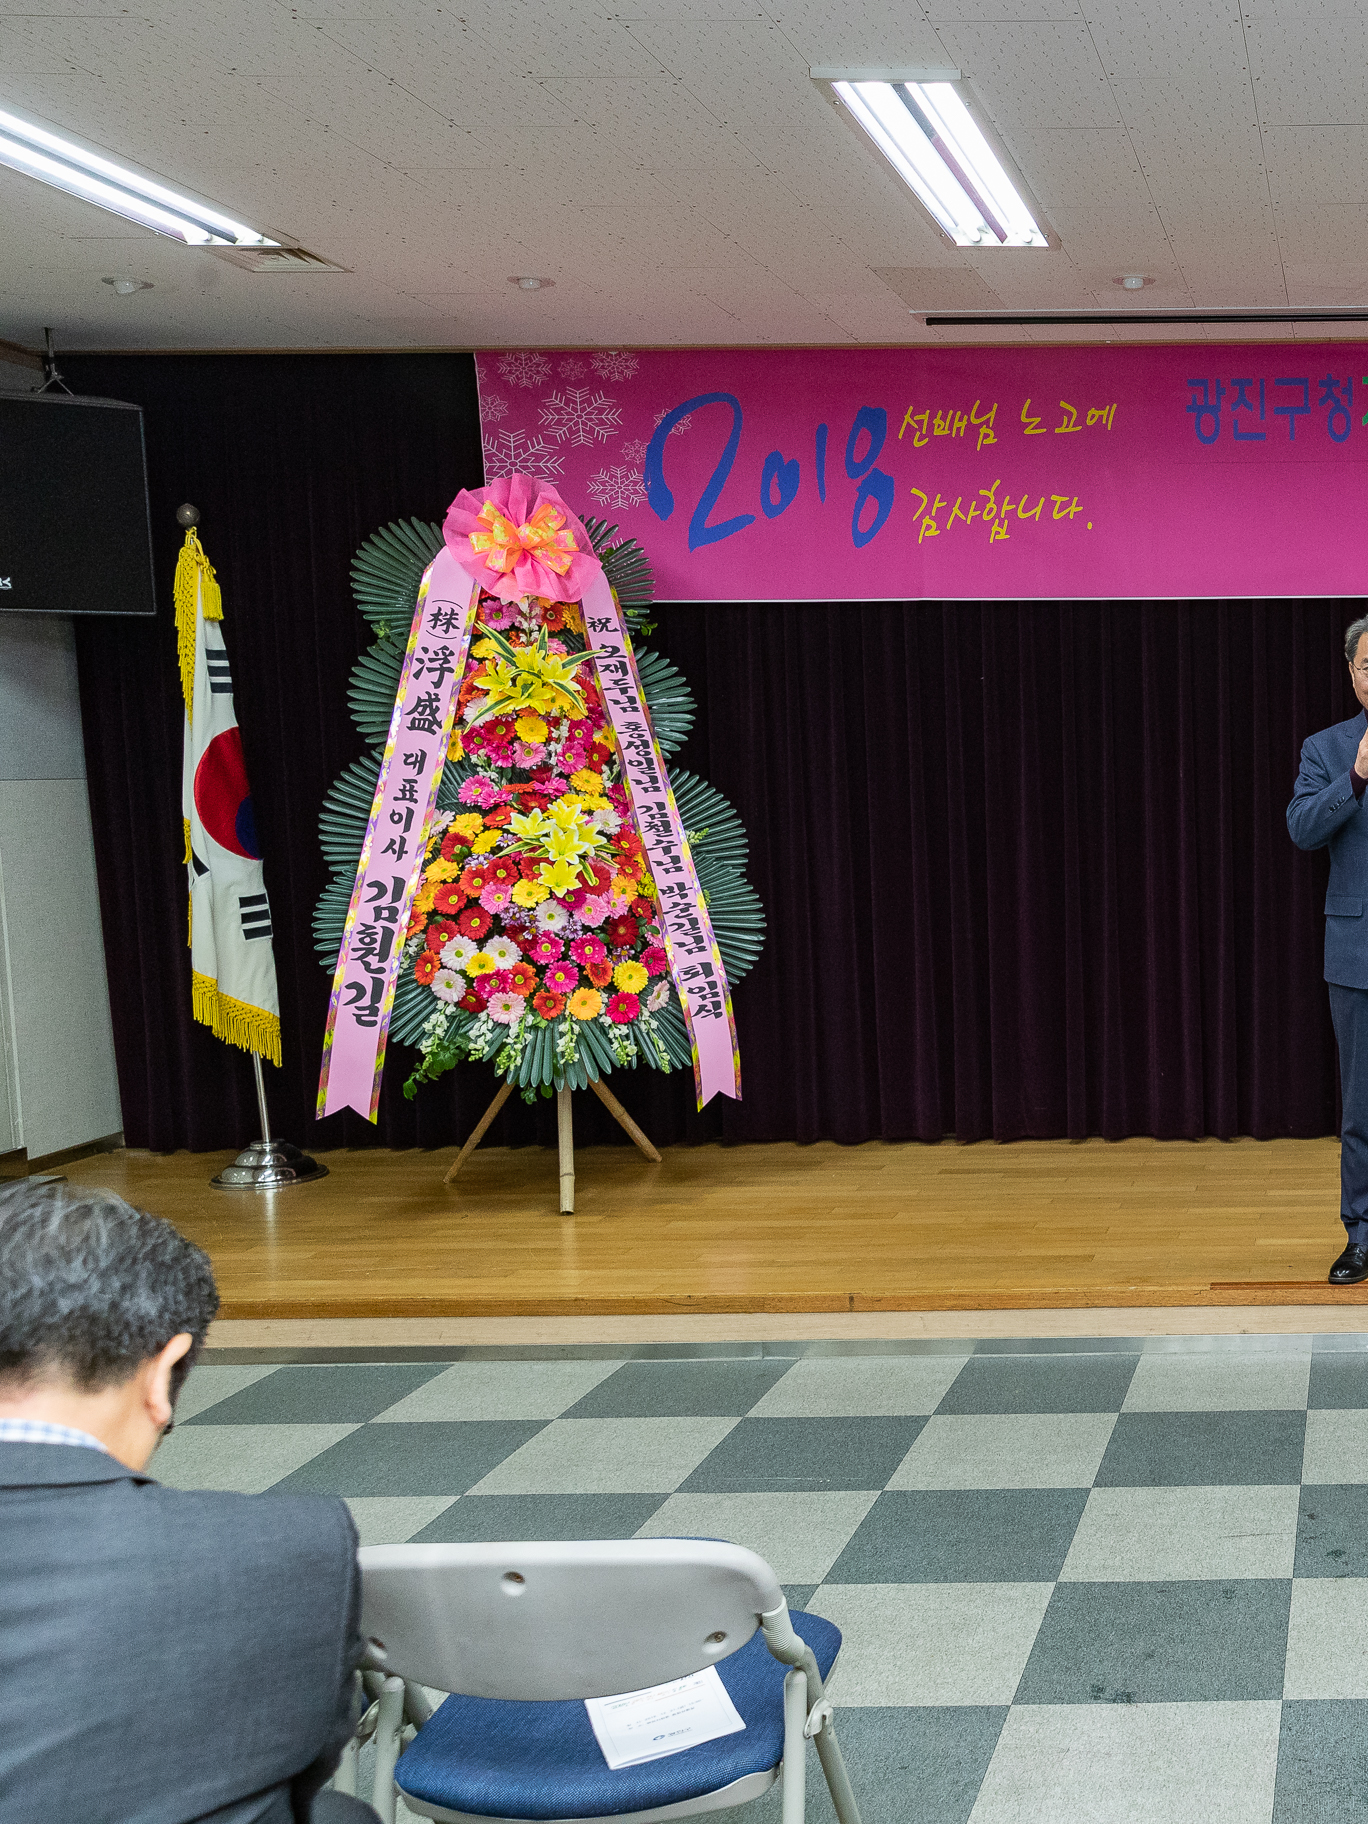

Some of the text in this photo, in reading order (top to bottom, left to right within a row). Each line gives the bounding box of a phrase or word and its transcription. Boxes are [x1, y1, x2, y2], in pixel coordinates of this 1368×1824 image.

[644, 391, 895, 552] 2018
[899, 399, 998, 451] 선배님
[910, 479, 1093, 544] 감사합니다.
[380, 748, 428, 863] 대표이사
[586, 616, 620, 633] 祝
[637, 801, 685, 875] 김철수님
[678, 961, 724, 1019] 퇴임식
